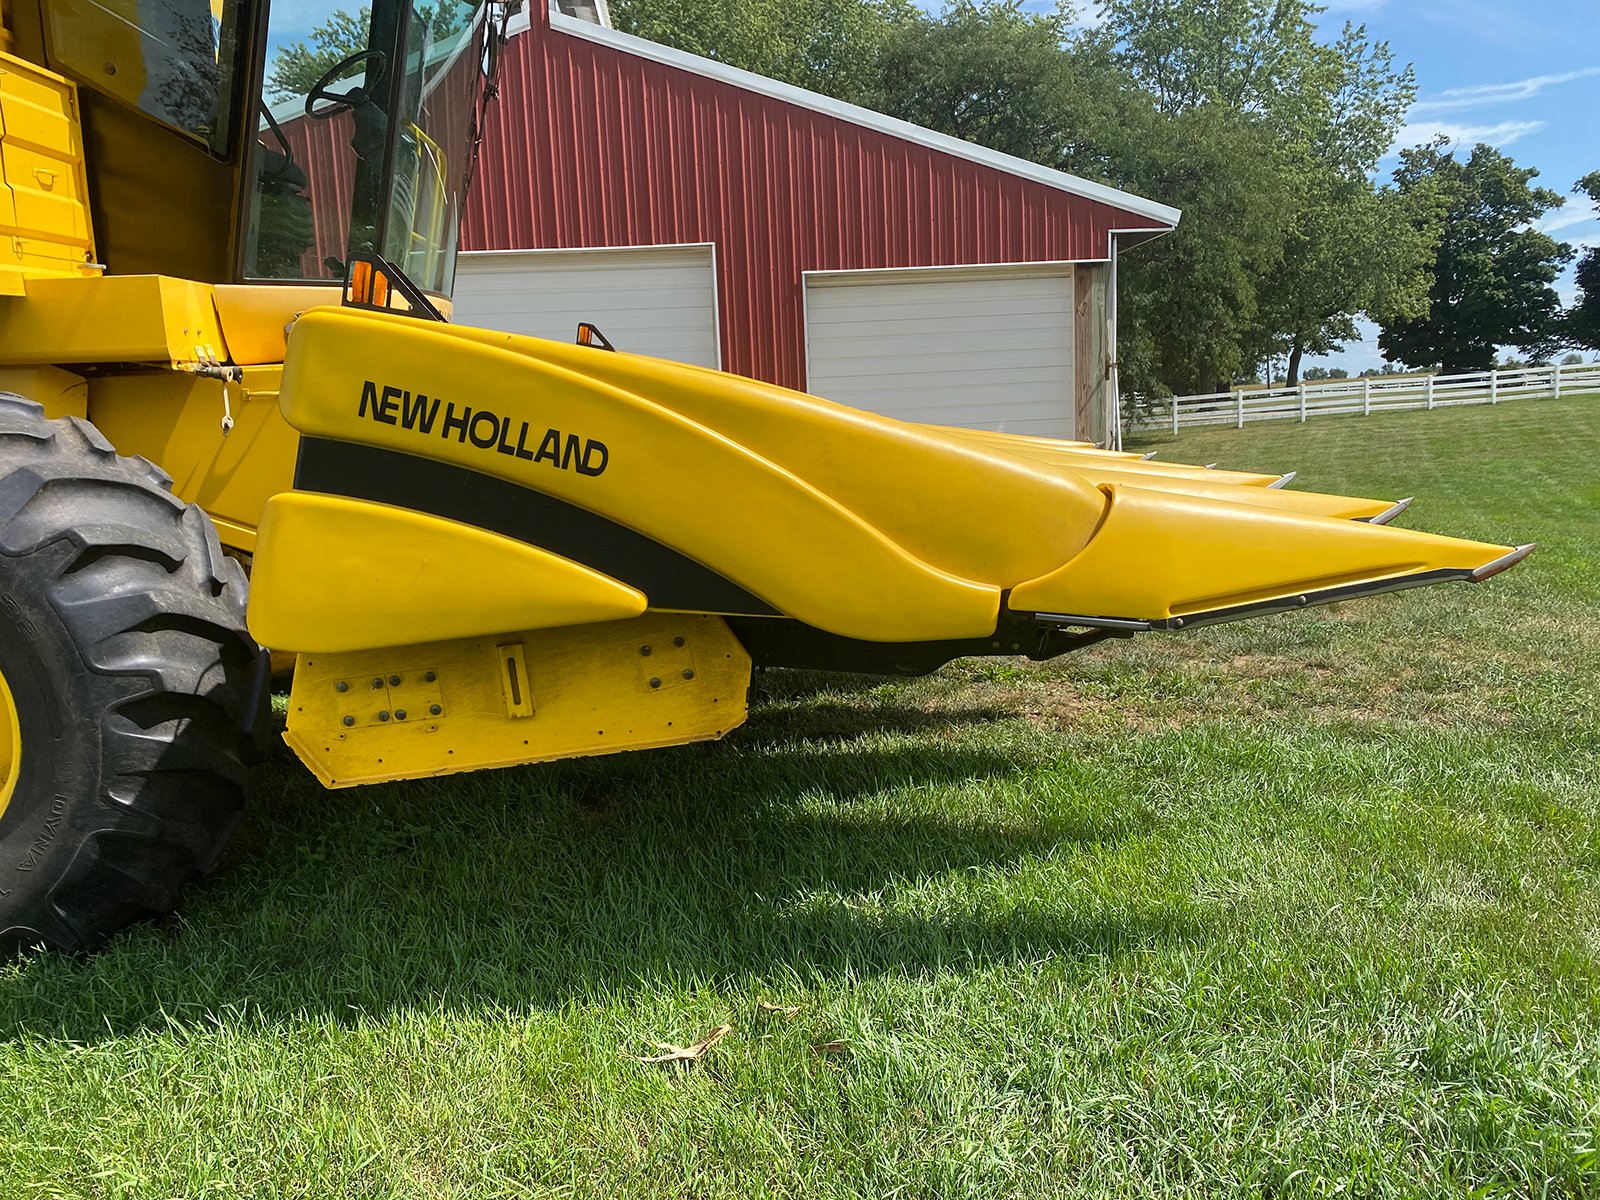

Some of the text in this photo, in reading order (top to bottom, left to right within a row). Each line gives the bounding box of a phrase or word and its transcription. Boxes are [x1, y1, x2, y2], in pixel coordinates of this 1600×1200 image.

[358, 380, 609, 477] NEW HOLLAND
[15, 793, 69, 872] DYNA
